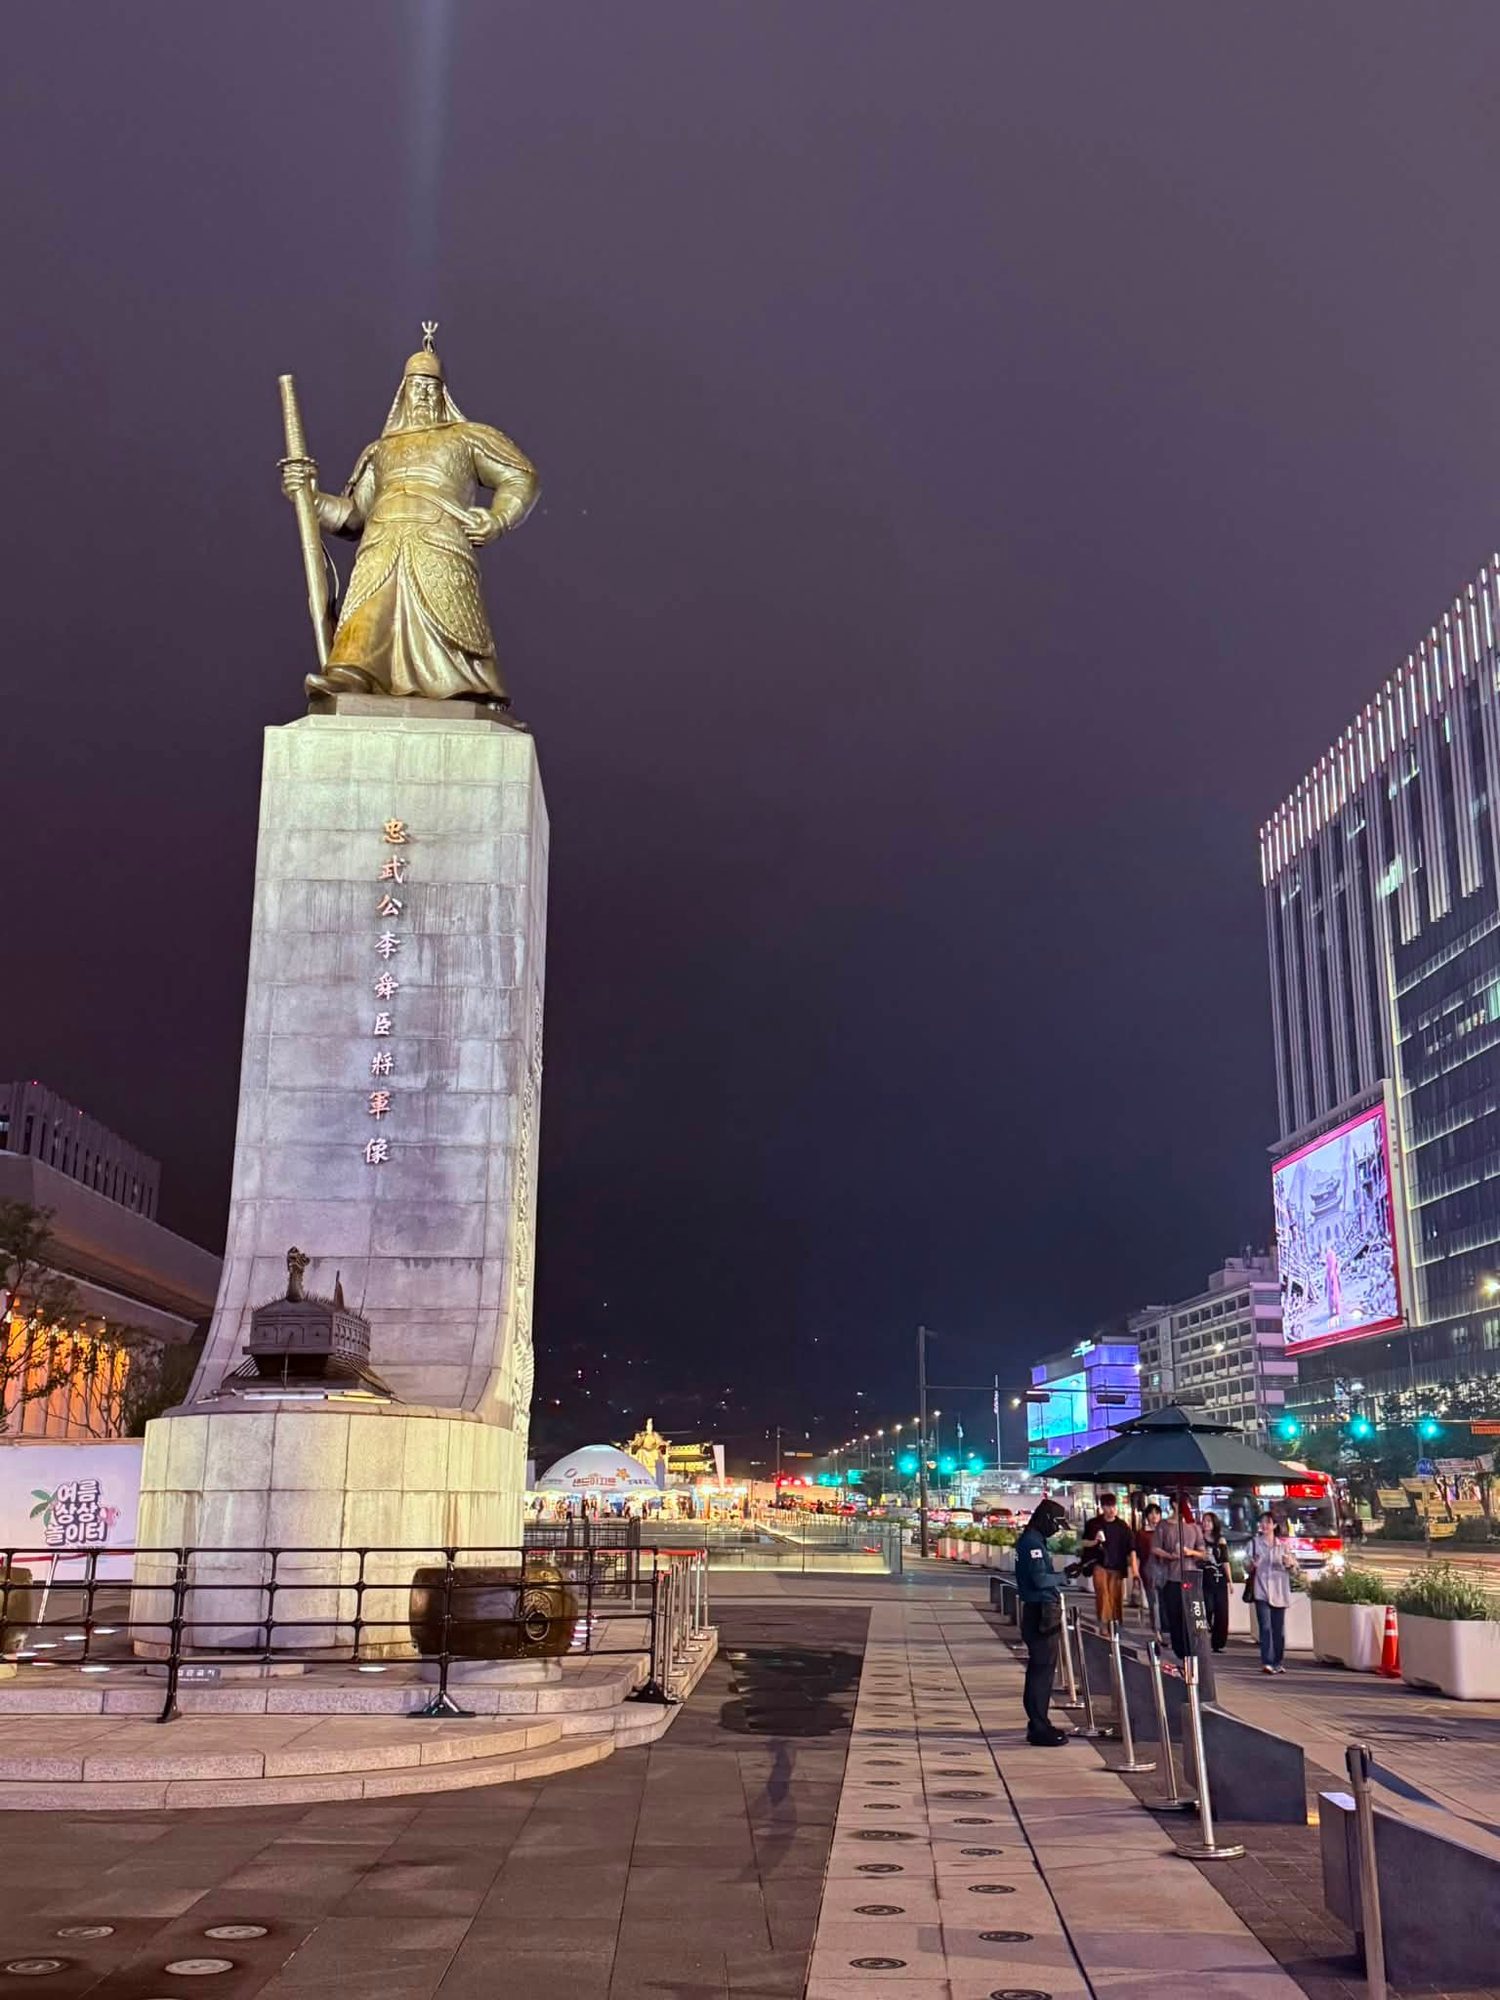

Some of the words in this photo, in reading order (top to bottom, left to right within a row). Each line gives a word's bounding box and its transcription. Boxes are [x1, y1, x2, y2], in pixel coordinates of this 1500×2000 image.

[57, 1480, 99, 1503] 여름
[55, 1501, 98, 1524] 상상
[45, 1521, 106, 1545] 놀이터
